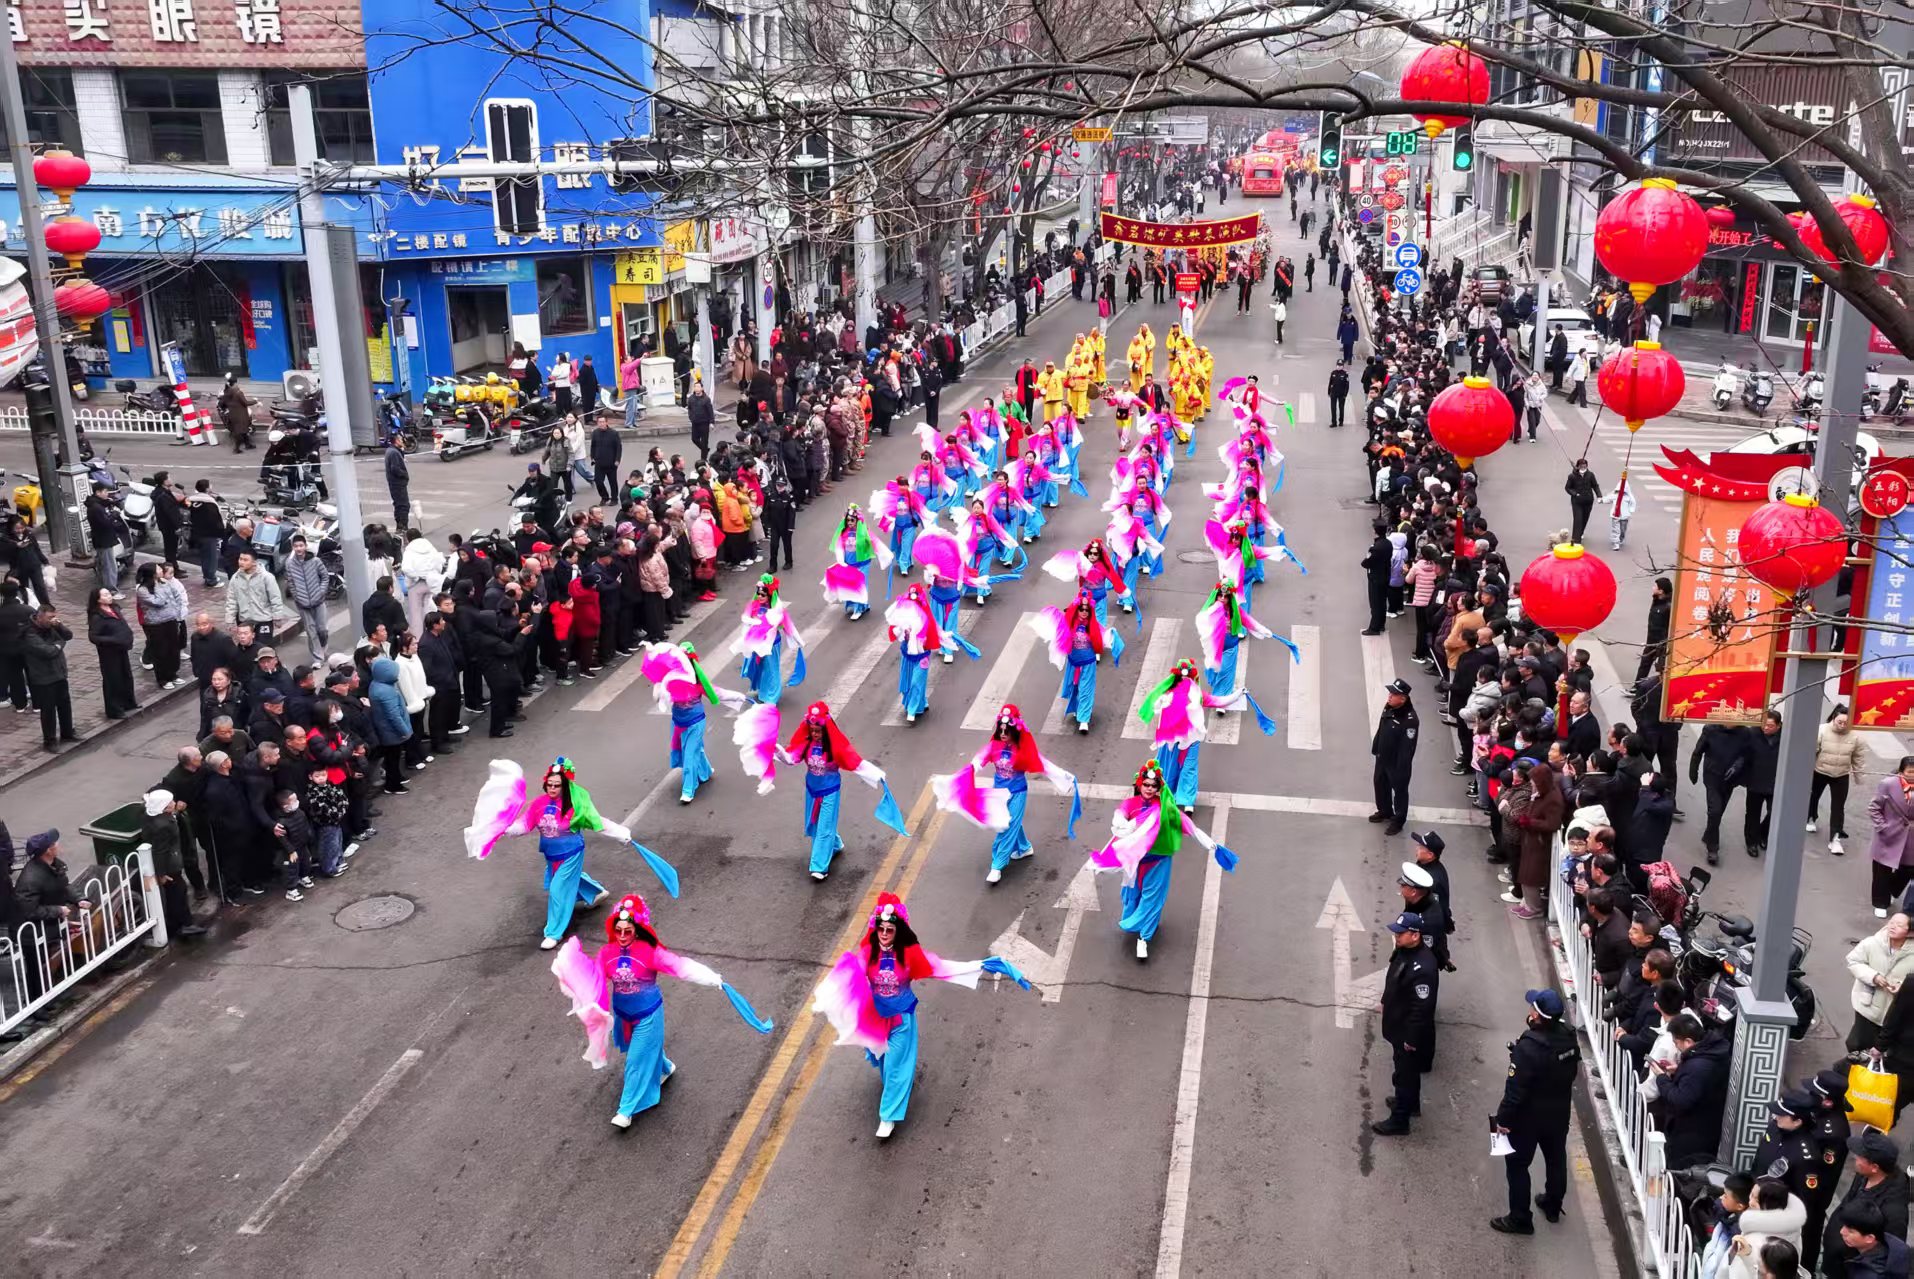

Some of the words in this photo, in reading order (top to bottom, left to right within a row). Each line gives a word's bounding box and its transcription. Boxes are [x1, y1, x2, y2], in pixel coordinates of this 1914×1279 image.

[1388, 132, 1415, 154] 08
[1362, 197, 1372, 205] 40
[396, 229, 469, 251] 二楼配镜
[625, 266, 656, 282] 寿司
[765, 266, 773, 278] 30
[1874, 480, 1900, 493] 五彩
[1689, 527, 1716, 640] 人民是阅卷人
